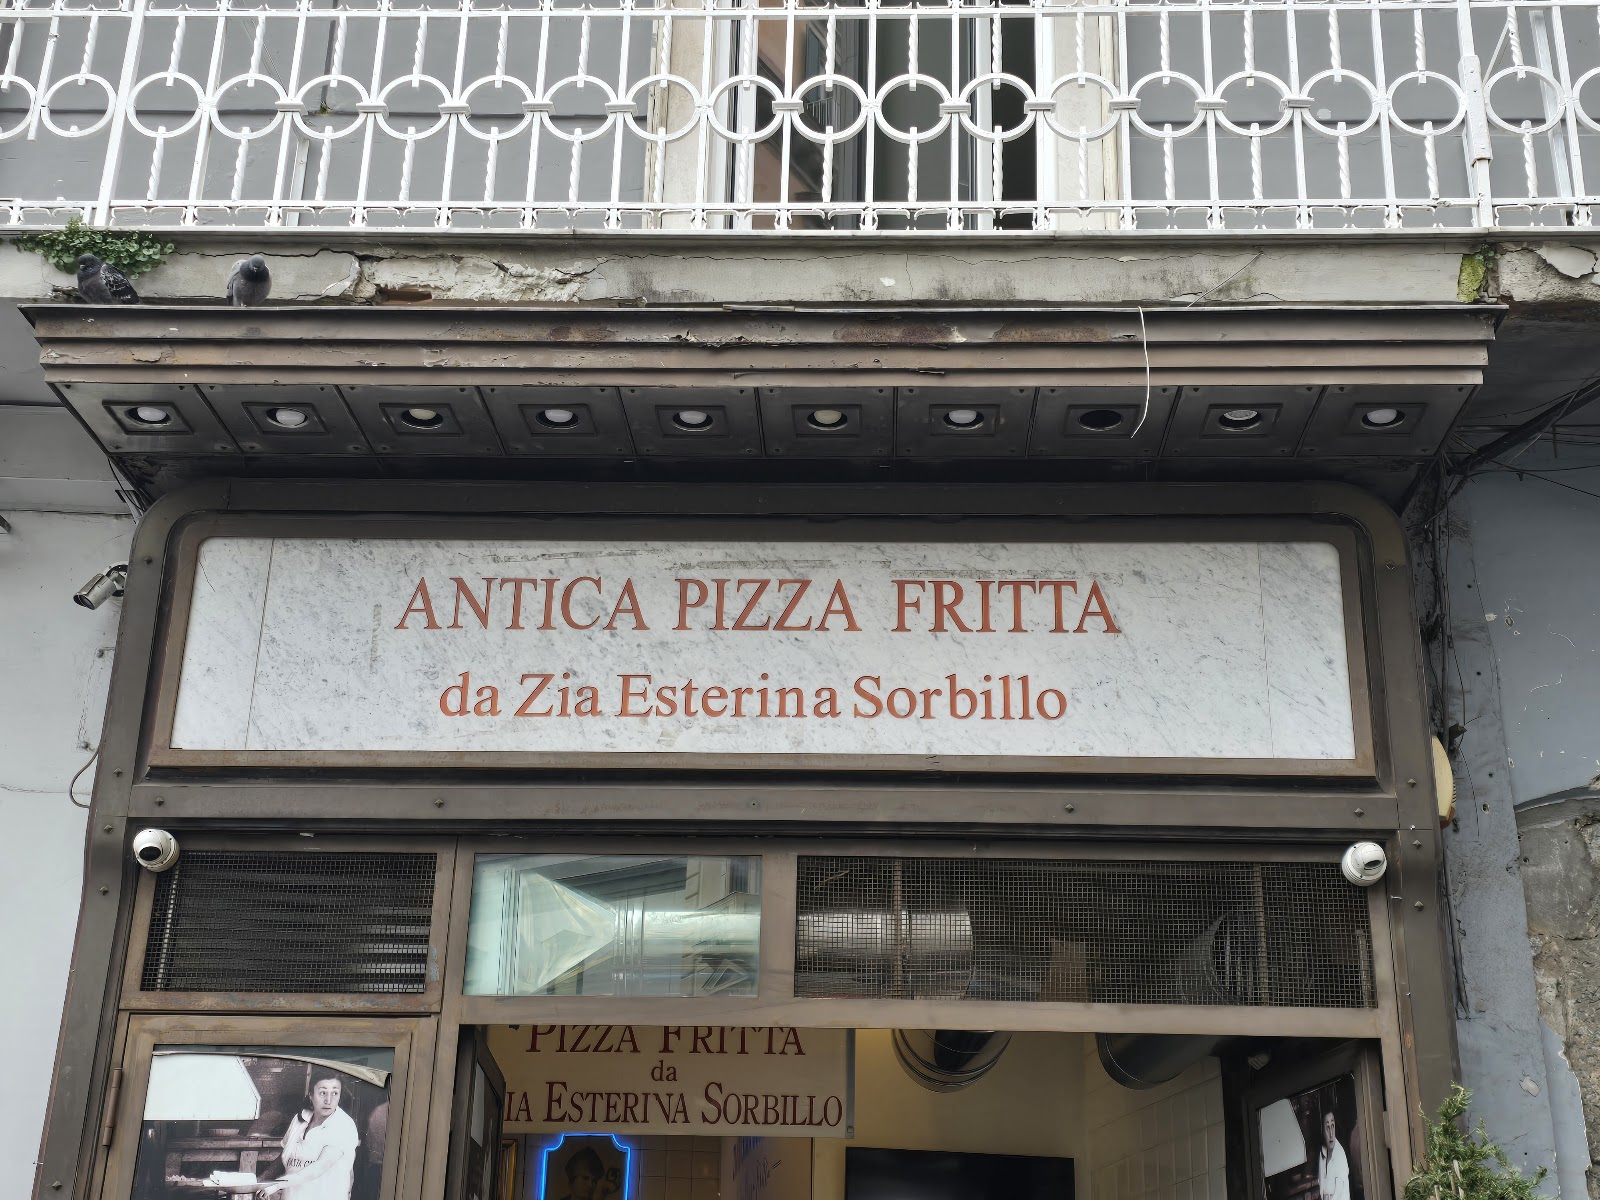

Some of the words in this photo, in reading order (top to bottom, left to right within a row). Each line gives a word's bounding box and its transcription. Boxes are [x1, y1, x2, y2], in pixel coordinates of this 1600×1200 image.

[394, 576, 650, 631] ANTICA
[672, 578, 863, 632] PIZZA
[891, 580, 1123, 634] FRITTA
[439, 671, 502, 717] da
[514, 672, 603, 718] Zia
[615, 672, 842, 719] Esterina
[853, 673, 1068, 721] Sorbillo
[526, 1025, 641, 1054] PIZZA
[658, 1026, 807, 1056] FRITTA
[650, 1060, 678, 1082] da
[505, 1091, 533, 1123] IA
[543, 1081, 691, 1125] ESTERINA
[701, 1082, 844, 1127] SORBILLO
